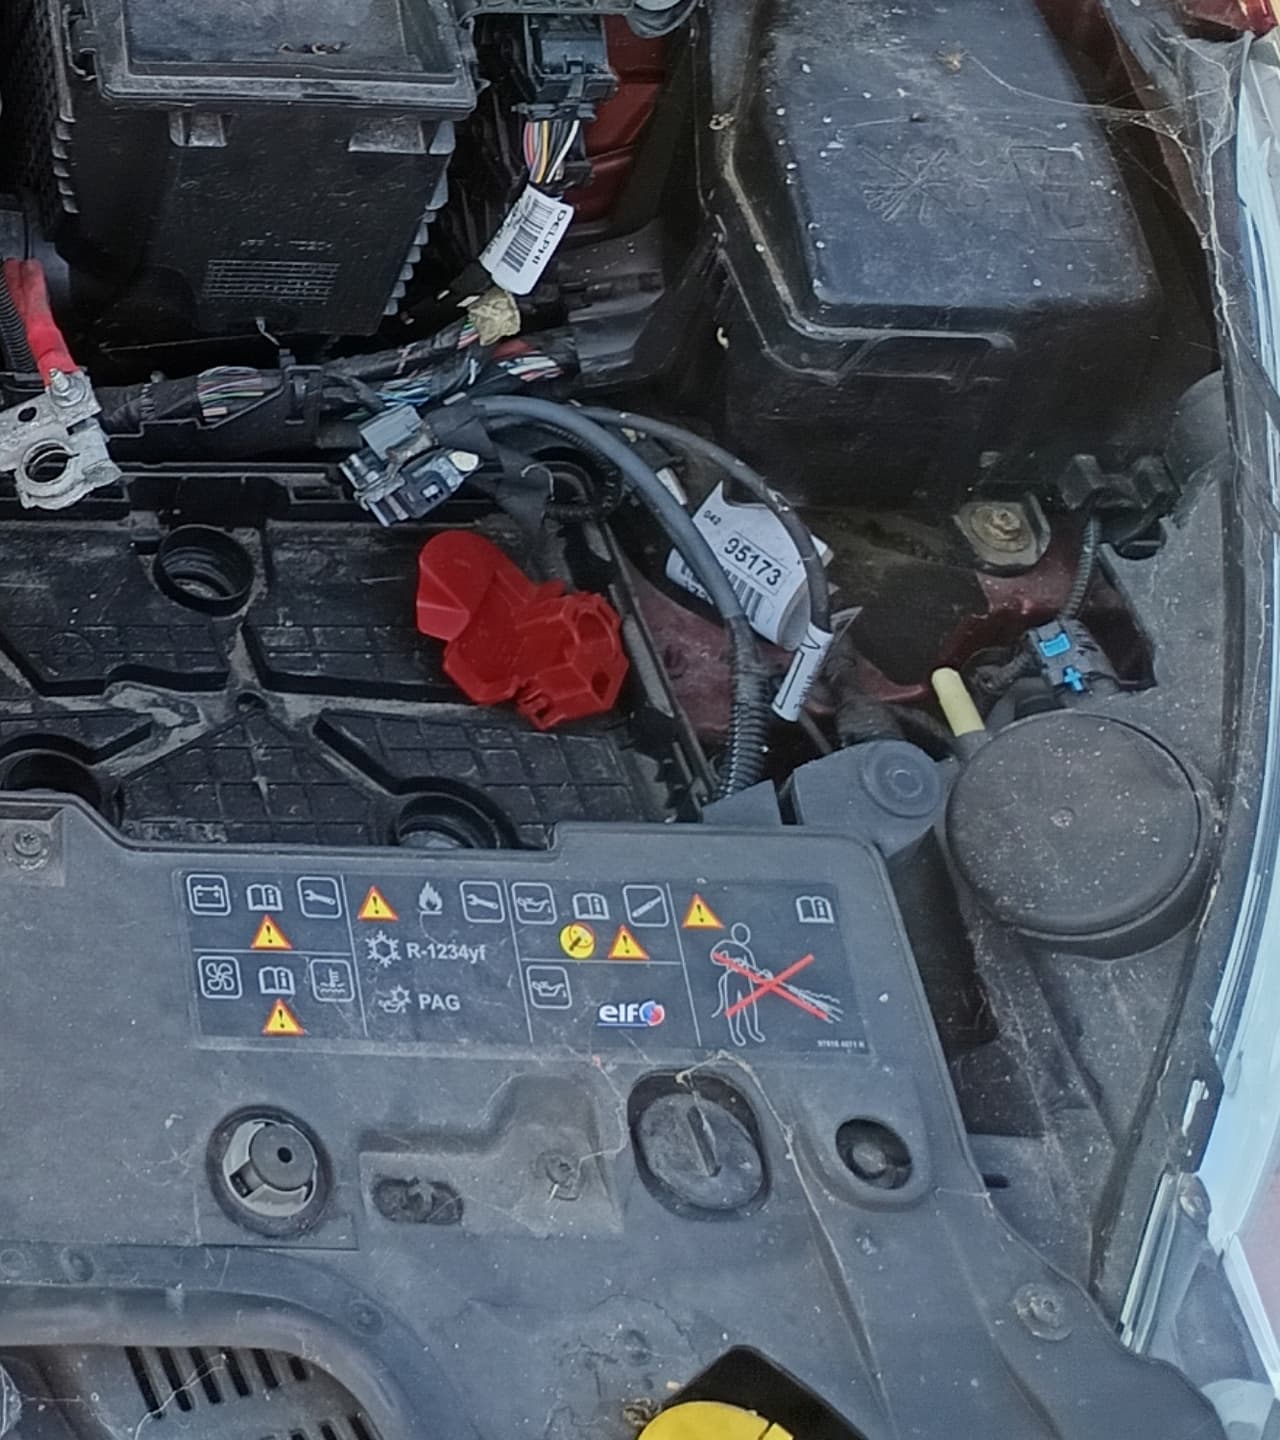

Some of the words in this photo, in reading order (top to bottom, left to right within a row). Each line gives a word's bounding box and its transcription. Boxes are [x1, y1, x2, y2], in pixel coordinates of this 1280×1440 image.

[531, 209, 568, 265] DELPHI
[723, 537, 783, 587] 95173
[405, 942, 487, 963] R-1234yf
[418, 992, 461, 1013] PAG
[597, 1002, 641, 1025] elf
